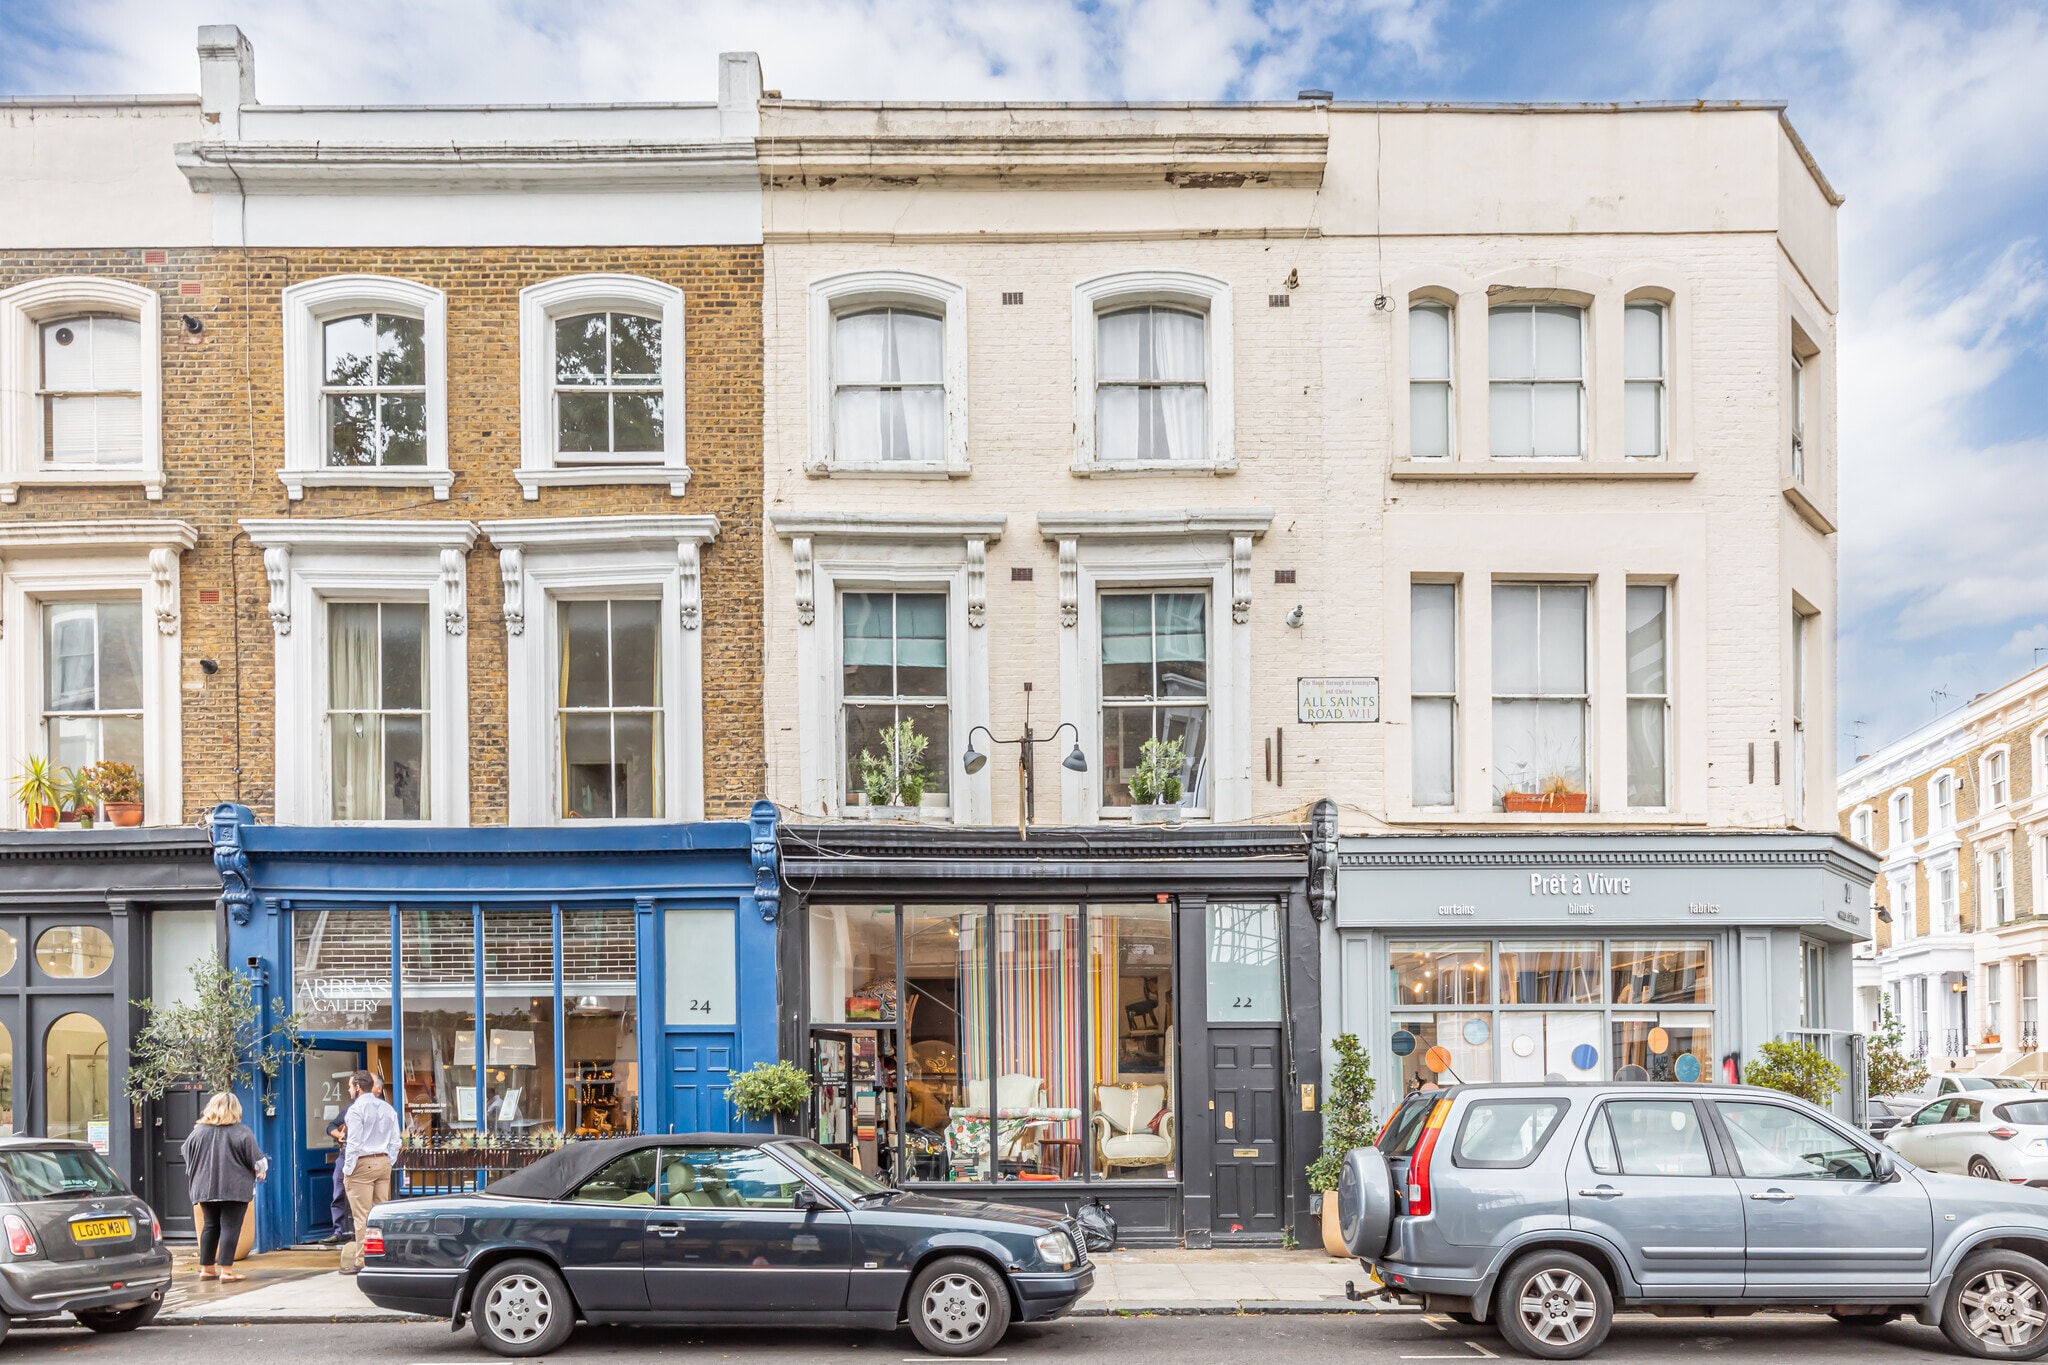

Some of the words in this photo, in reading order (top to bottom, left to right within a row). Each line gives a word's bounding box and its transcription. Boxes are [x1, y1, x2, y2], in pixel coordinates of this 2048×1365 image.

[1312, 680, 1325, 688] Royal
[1326, 680, 1345, 688] Borough
[1303, 696, 1327, 707] ALL
[1330, 696, 1375, 707] SAINTS
[1530, 873, 1567, 895] Prêt
[1572, 873, 1583, 895] à
[1587, 872, 1631, 895] Vivre
[1438, 903, 1475, 915] curtains
[1568, 903, 1595, 915] blinds
[1689, 902, 1720, 914] fabrics
[315, 999, 380, 1012] GALLERY
[689, 999, 711, 1014] 24
[1232, 996, 1252, 1008] 22
[321, 1081, 342, 1102] 24
[78, 1223, 107, 1238] LG06
[108, 1221, 126, 1235] MBV
